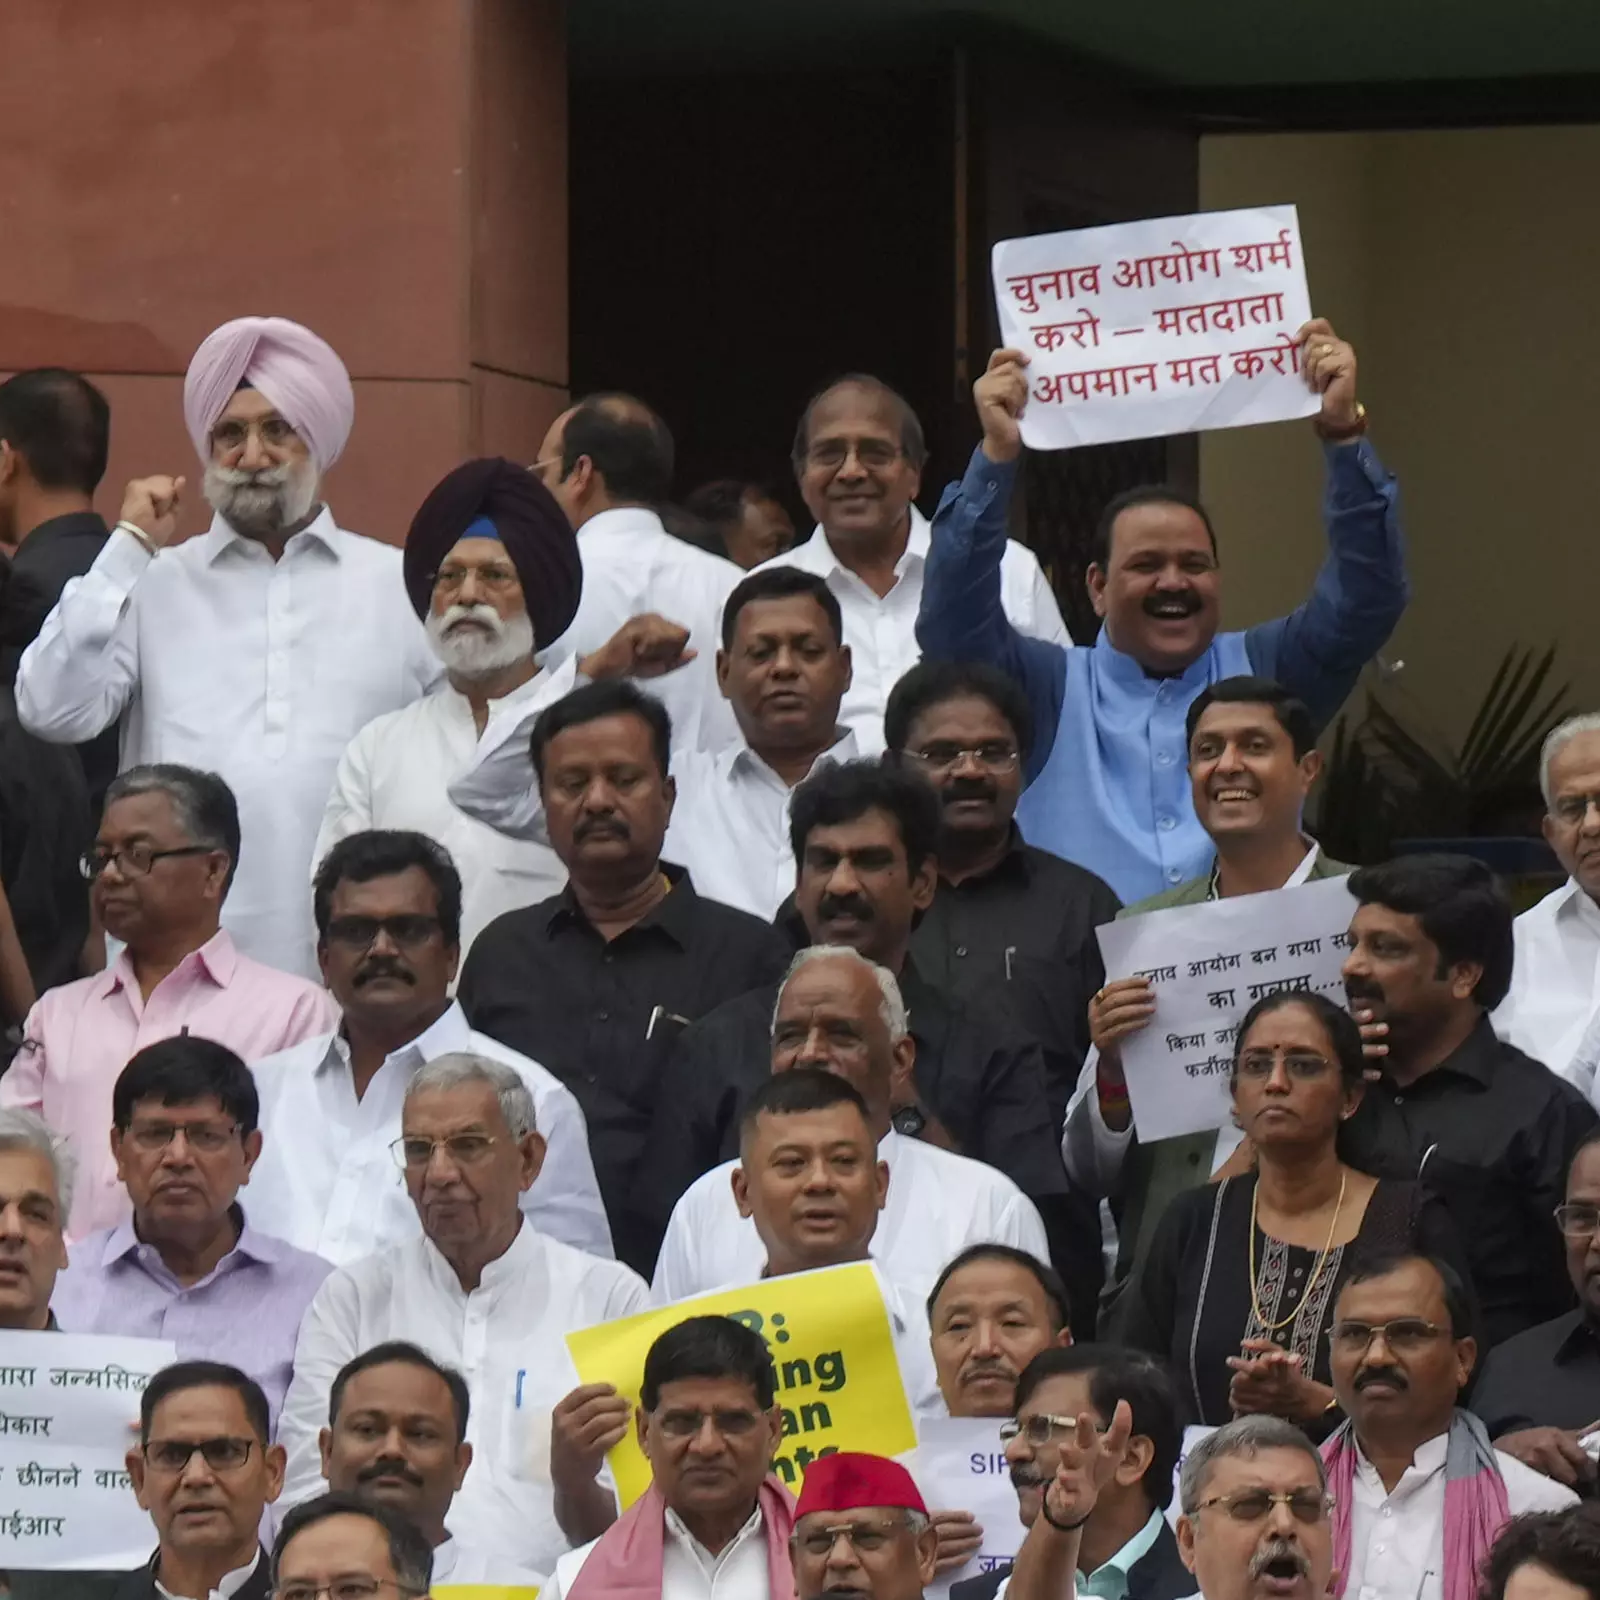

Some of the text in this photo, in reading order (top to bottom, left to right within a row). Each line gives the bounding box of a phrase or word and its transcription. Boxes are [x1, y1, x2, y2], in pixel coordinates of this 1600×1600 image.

[1007, 229, 1292, 313] चुनाव आयोग शर्म
[1029, 307, 1100, 352] करो
[1152, 293, 1285, 336] मतदाता
[1032, 332, 1300, 404] अपमान मत करो
[1188, 953, 1241, 977] आयोग
[1287, 938, 1322, 958] गया
[1207, 988, 1236, 1009] का
[1166, 1032, 1206, 1053] किया
[16, 1461, 82, 1489] छीनने
